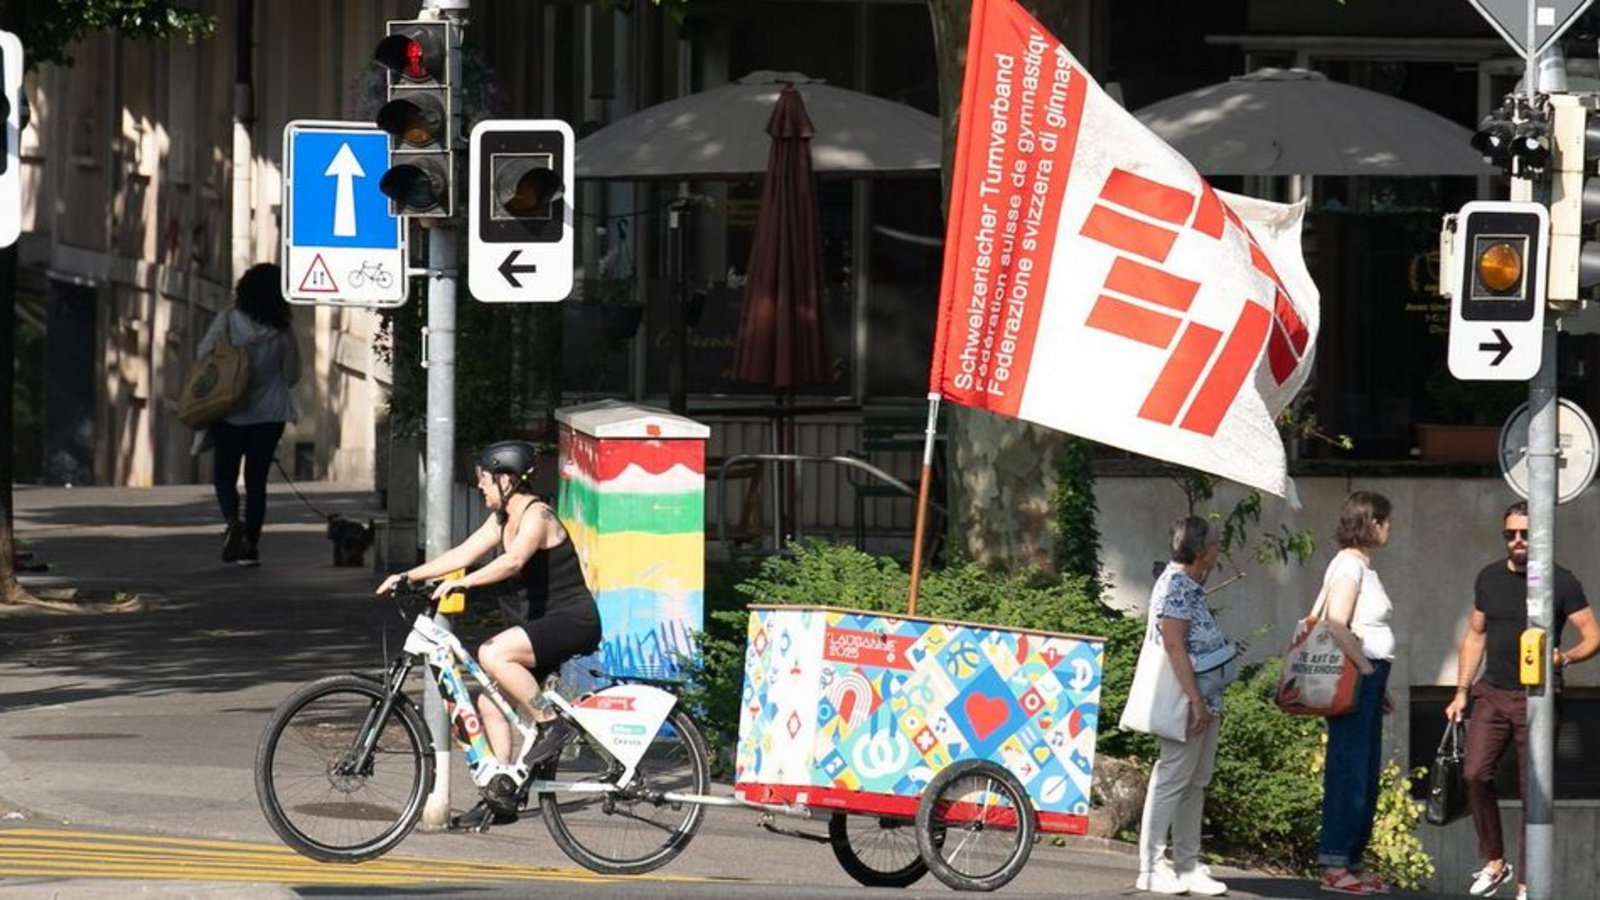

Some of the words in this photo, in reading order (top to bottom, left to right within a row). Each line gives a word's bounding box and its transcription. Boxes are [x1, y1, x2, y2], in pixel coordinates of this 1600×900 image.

[954, 203, 997, 391] Schweizerischer
[980, 54, 1015, 197] Turnverband
[988, 257, 1033, 397] Federazione
[1022, 158, 1054, 252] svizzera
[1038, 131, 1058, 153] di
[1000, 195, 1021, 266] suisse
[1013, 160, 1028, 188] de
